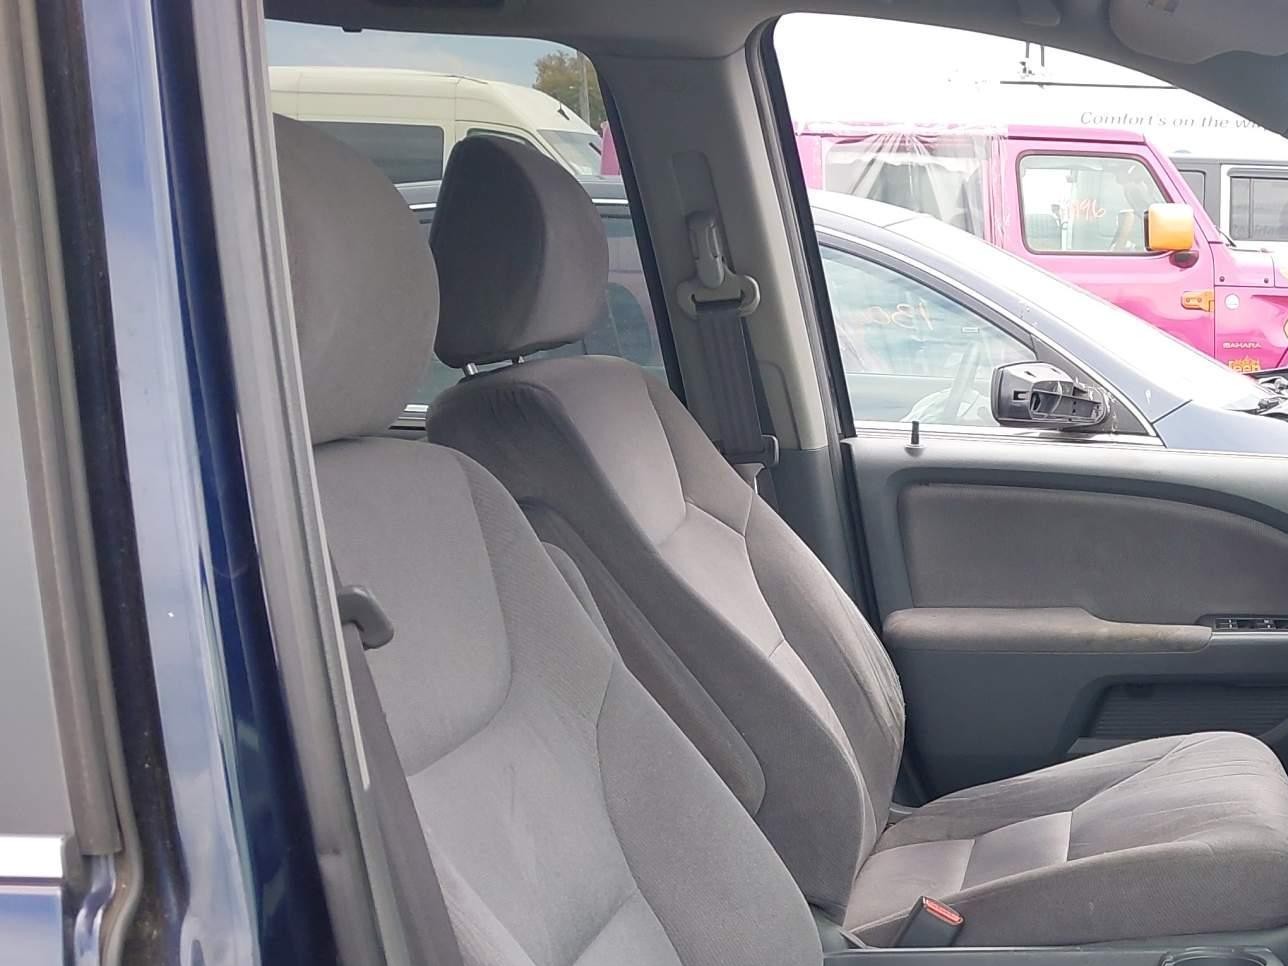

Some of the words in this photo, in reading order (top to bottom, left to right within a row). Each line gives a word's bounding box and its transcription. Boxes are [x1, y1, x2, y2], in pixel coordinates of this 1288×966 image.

[1172, 115, 1195, 127] on
[1201, 116, 1230, 128] the
[1222, 341, 1262, 350] SAHARA
